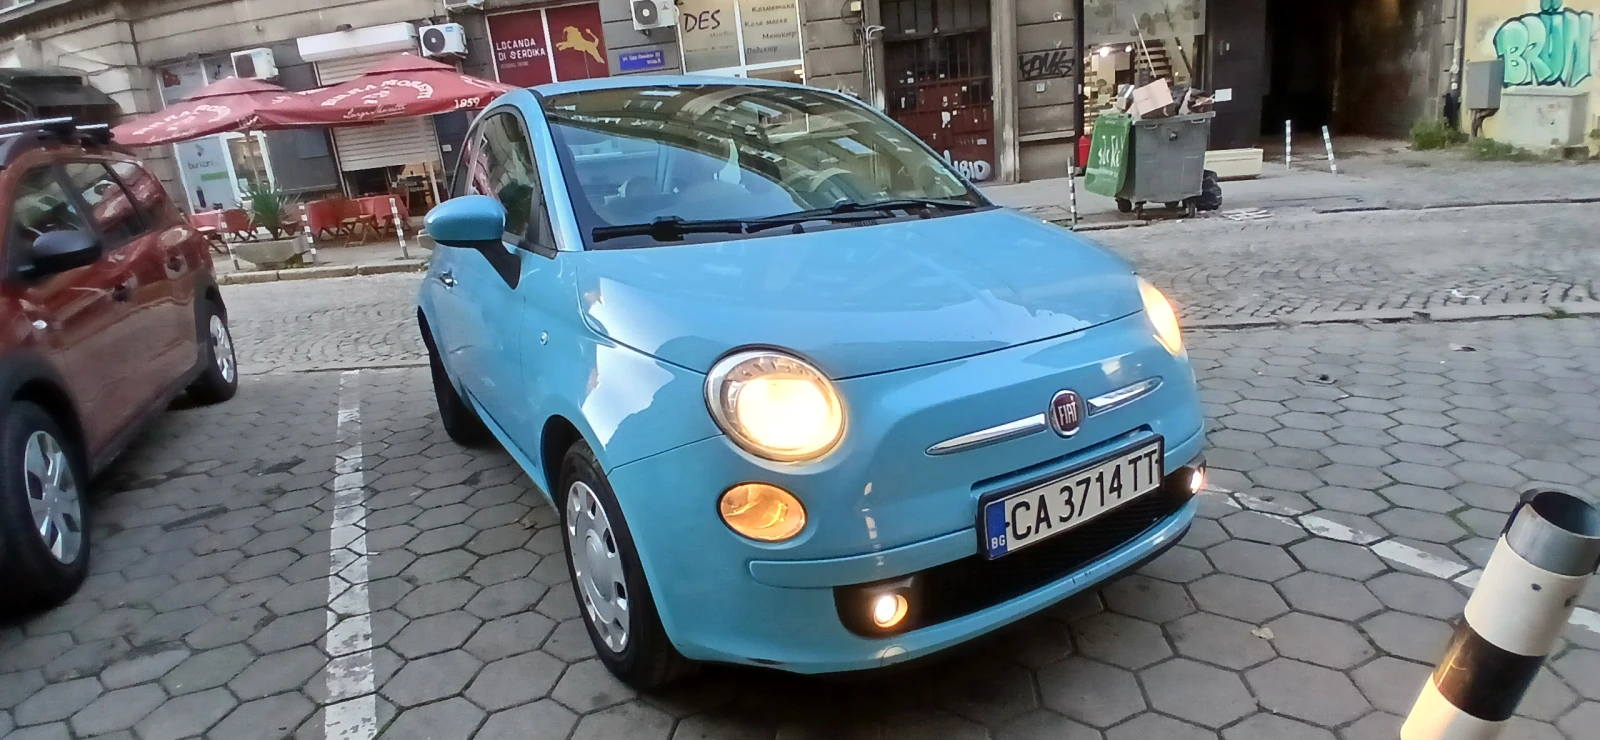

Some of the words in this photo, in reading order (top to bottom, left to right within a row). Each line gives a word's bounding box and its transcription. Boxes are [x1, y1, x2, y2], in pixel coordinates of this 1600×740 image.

[683, 9, 721, 33] DES
[496, 38, 536, 50] LOCANDA
[498, 52, 506, 61] DI
[510, 47, 546, 60] SERDIKA
[454, 96, 480, 109] 1859
[1057, 401, 1077, 426] FIAT
[1010, 493, 1052, 541] CA
[1058, 463, 1123, 523] 3714
[1127, 449, 1158, 492] TT
[991, 534, 1006, 550] BG
